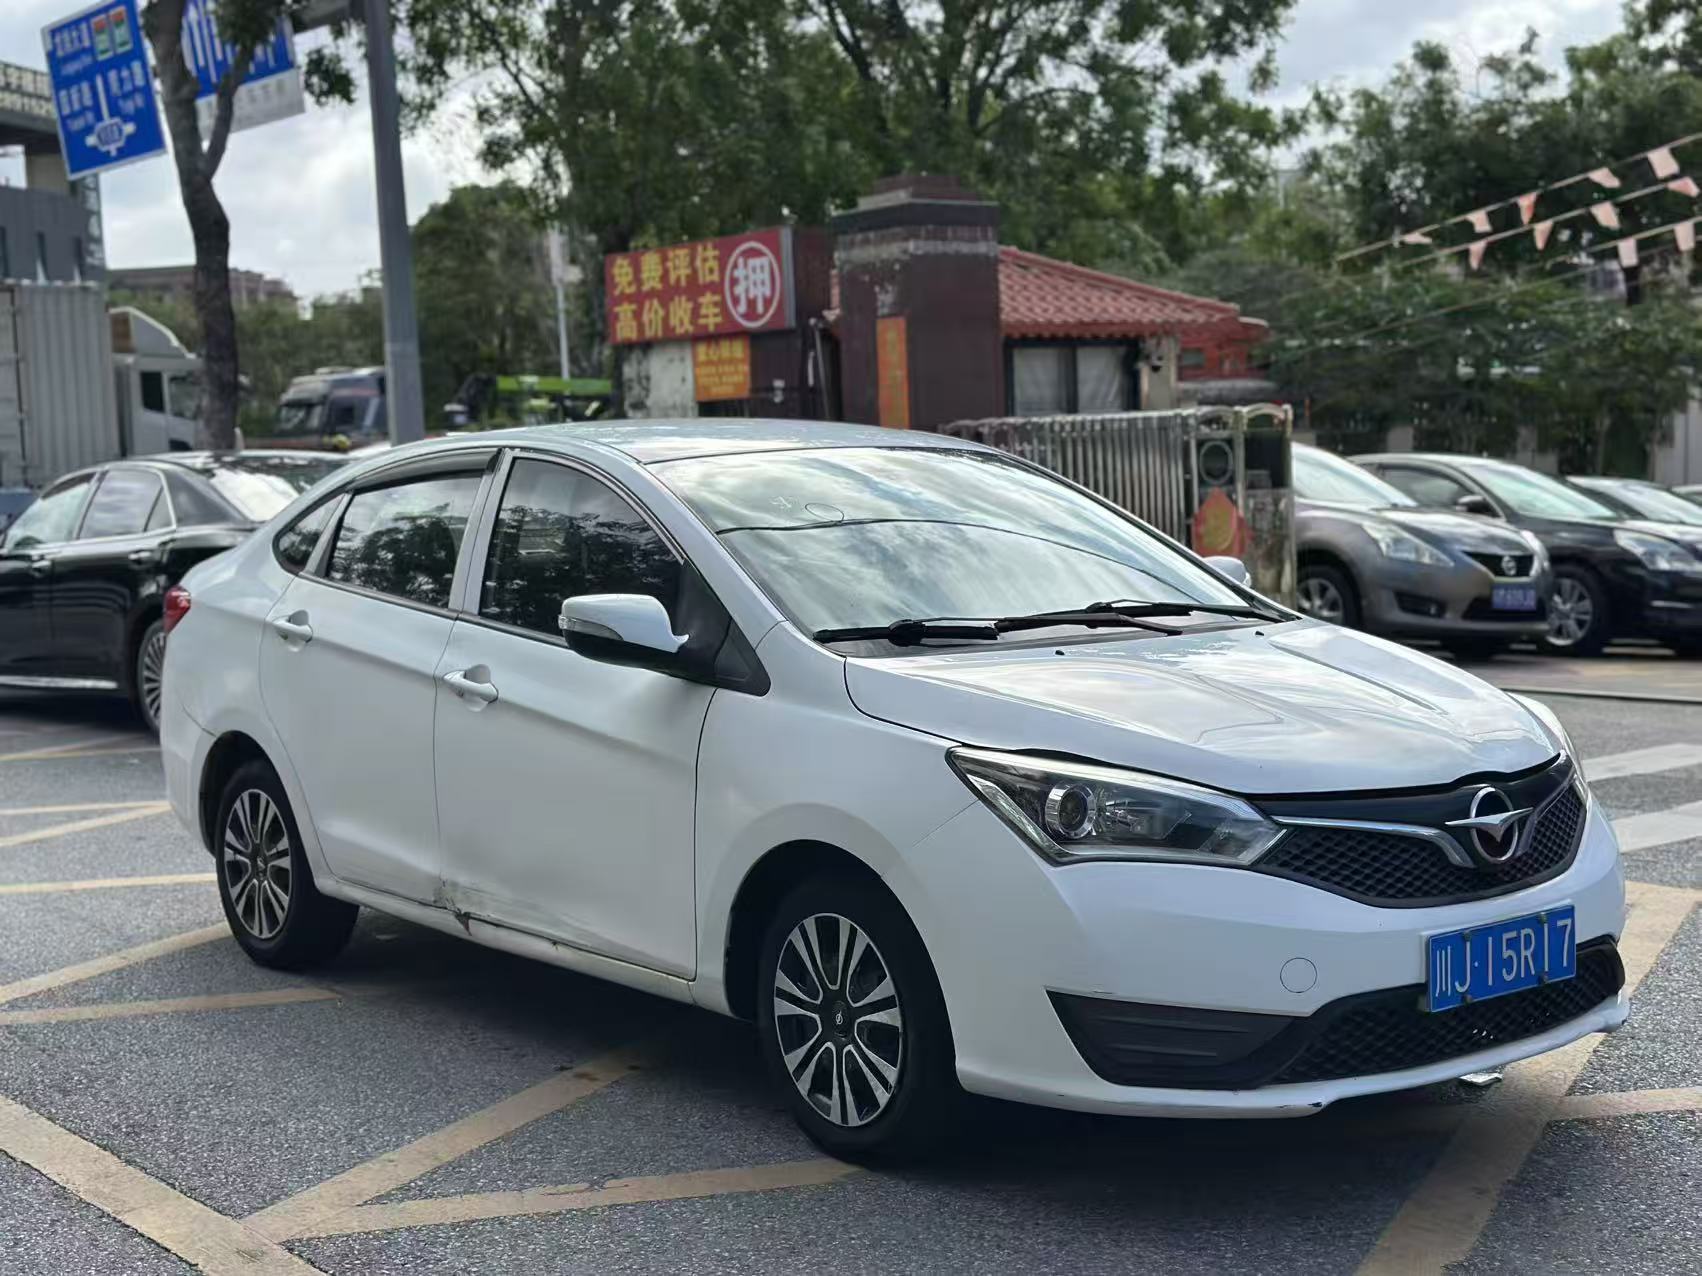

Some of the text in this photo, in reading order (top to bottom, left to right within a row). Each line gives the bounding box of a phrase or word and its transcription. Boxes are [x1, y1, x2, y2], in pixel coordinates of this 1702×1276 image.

[611, 242, 719, 294] 免费评估
[734, 257, 771, 314] 押
[613, 291, 722, 339] 高价收车
